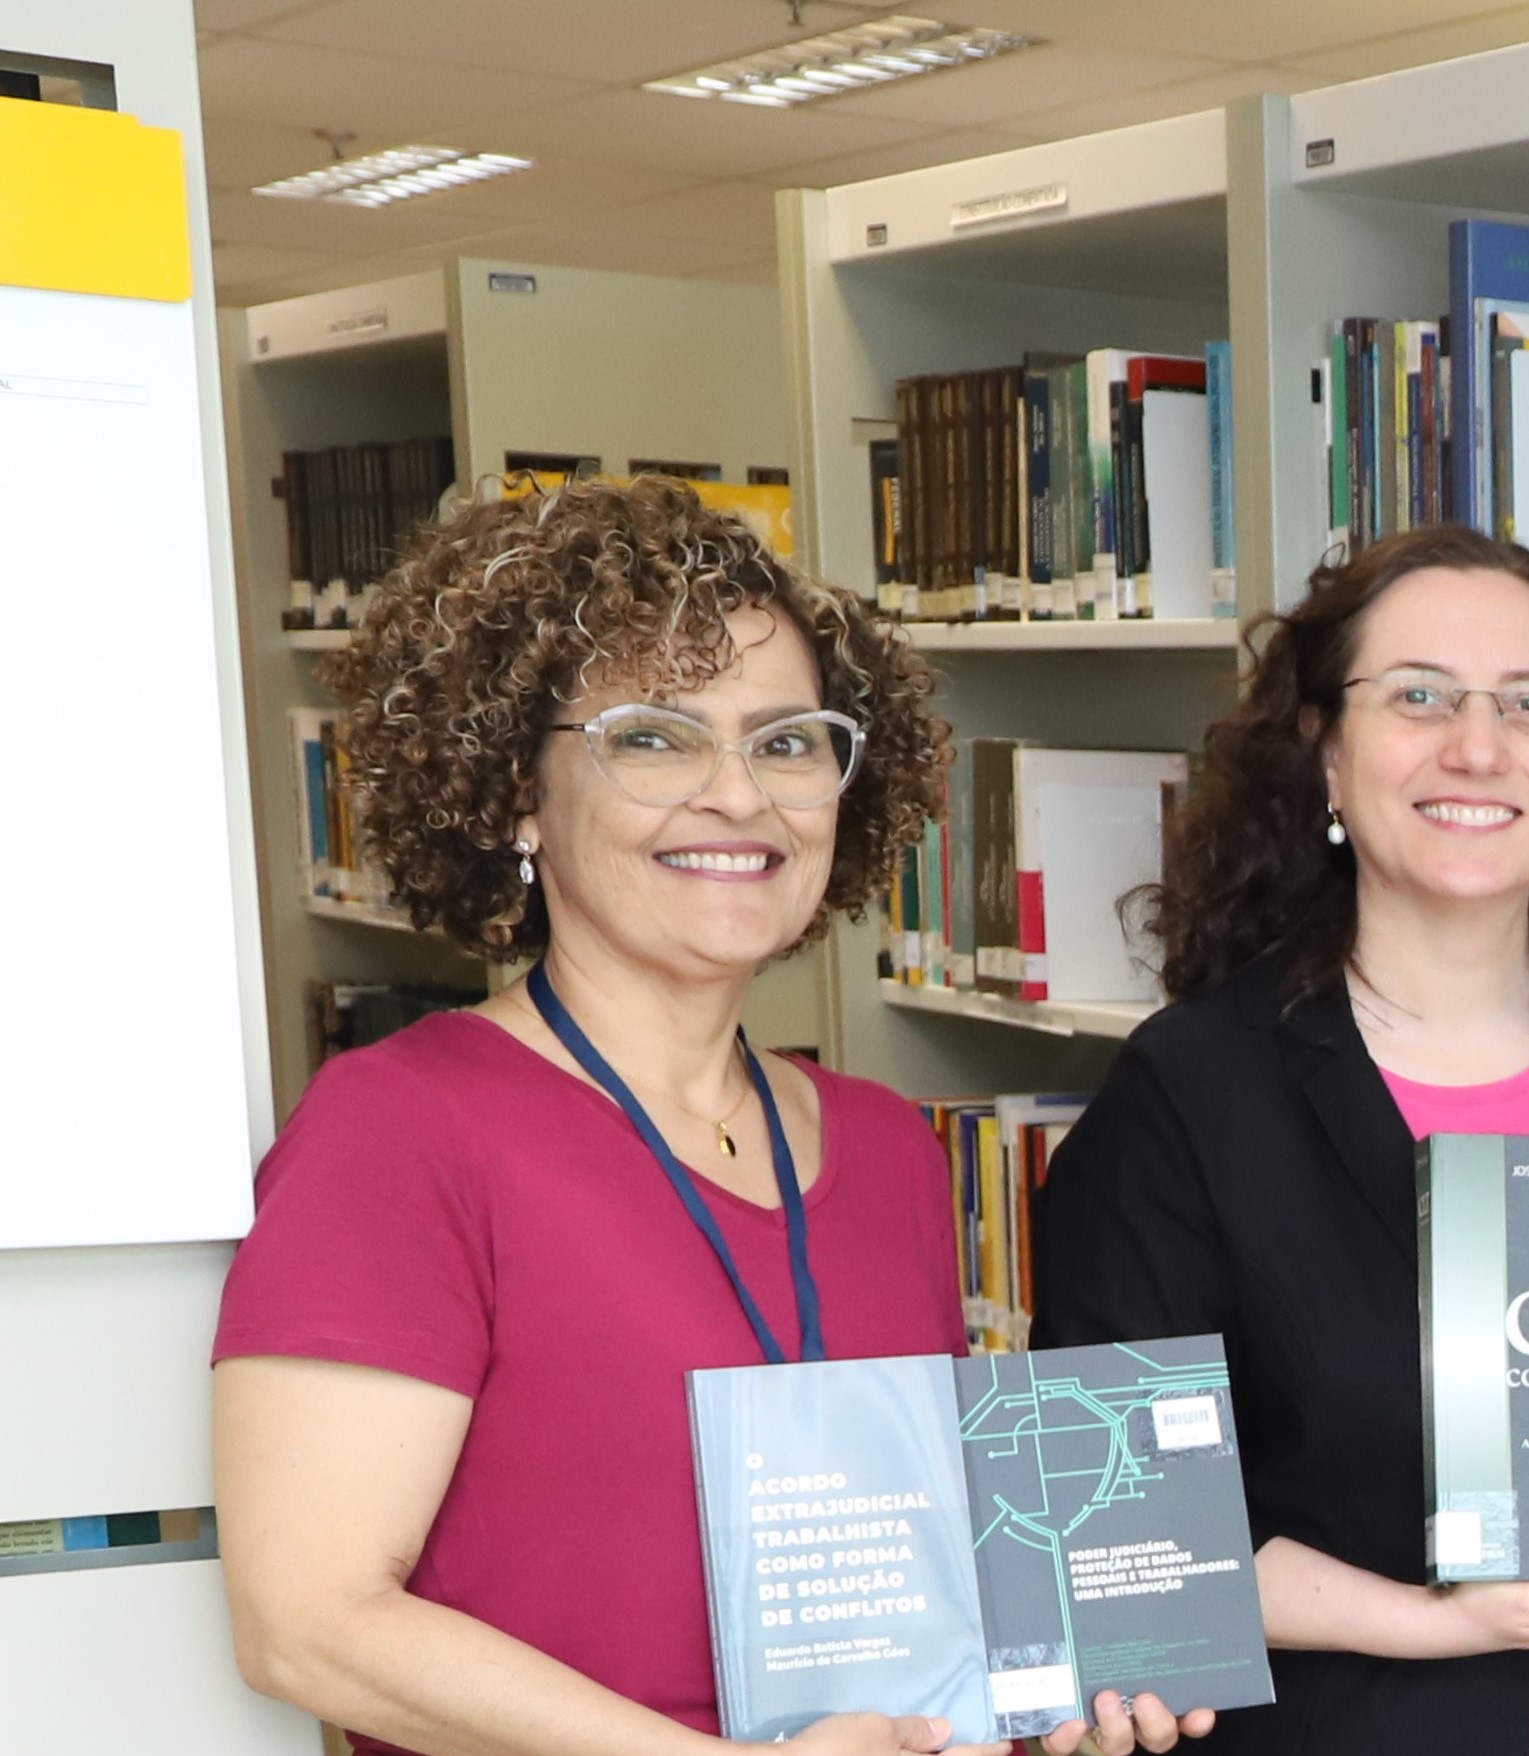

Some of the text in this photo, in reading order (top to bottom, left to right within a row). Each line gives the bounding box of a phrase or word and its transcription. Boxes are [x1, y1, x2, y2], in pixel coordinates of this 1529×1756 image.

[745, 1452, 764, 1470] O
[748, 1472, 847, 1498] ACORDO
[751, 1491, 931, 1524] EXTRAJUDICIAL
[753, 1518, 912, 1549] TRABALHISTA
[756, 1543, 914, 1576] COMO FORMA
[1068, 1540, 1179, 1563] PODER JUDICIÁRIO,
[1070, 1552, 1192, 1576] PROTEÇÃO DE DADOS
[758, 1568, 904, 1602] DE SOLUÇÃO
[1072, 1560, 1240, 1588] PESSOAIS E TRABALHADORES:
[1074, 1577, 1183, 1601] UMA INTRODUÇÃO
[761, 1595, 927, 1628] DE CONFLITOS
[765, 1637, 891, 1659] Eduardo Batista Vargas
[766, 1656, 814, 1672] Maurício
[833, 1650, 881, 1664] Carvalho
[883, 1646, 911, 1659] Góes
